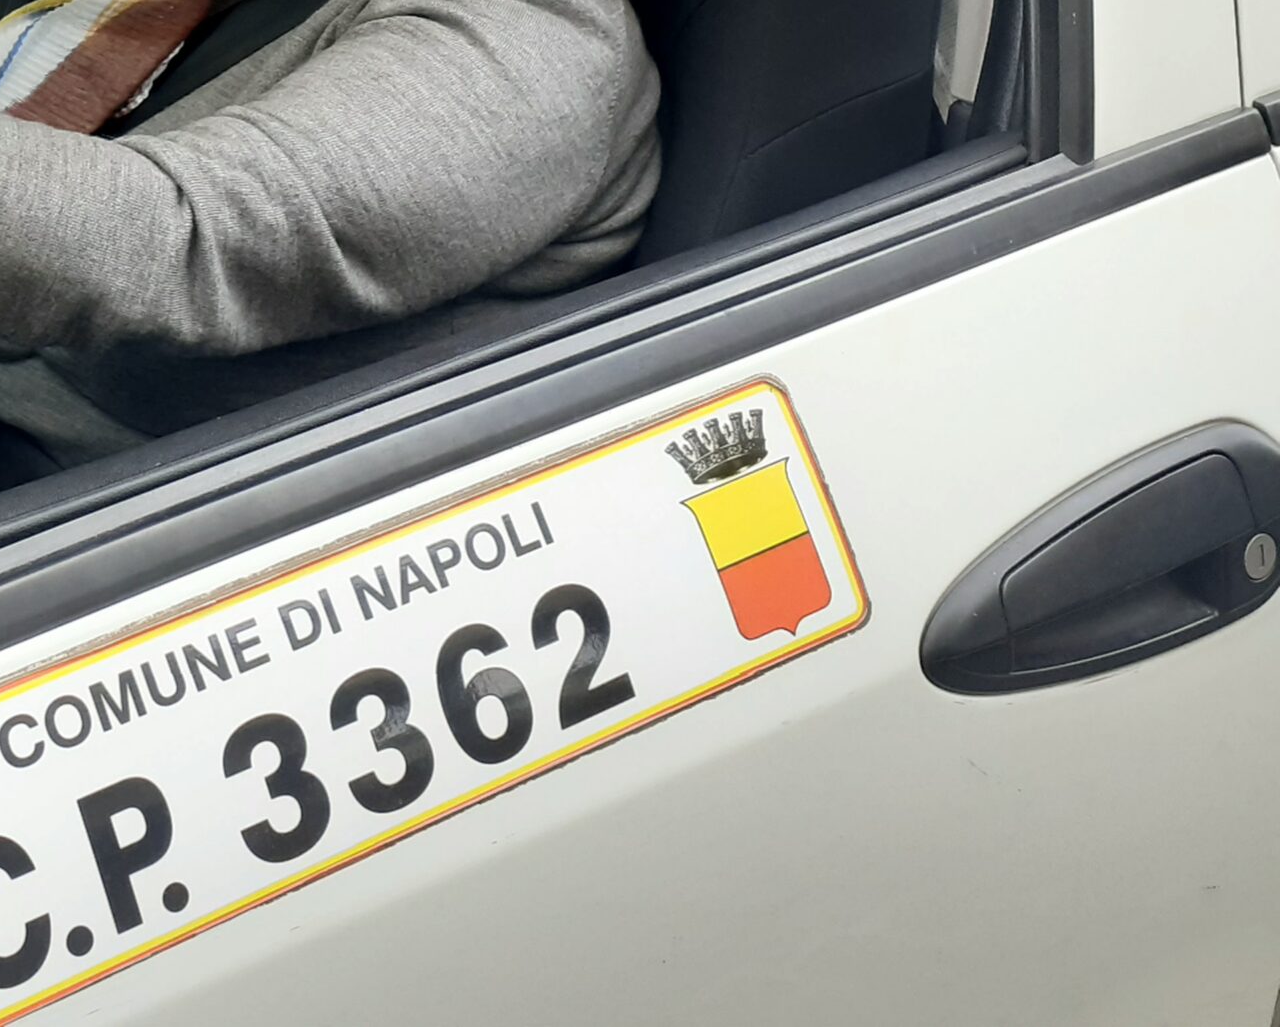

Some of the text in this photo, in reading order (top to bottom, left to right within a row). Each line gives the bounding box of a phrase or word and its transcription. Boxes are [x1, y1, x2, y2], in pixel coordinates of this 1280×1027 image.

[278, 589, 342, 652] DI
[350, 501, 556, 621] NAPOLI
[222, 583, 637, 864] 3362
